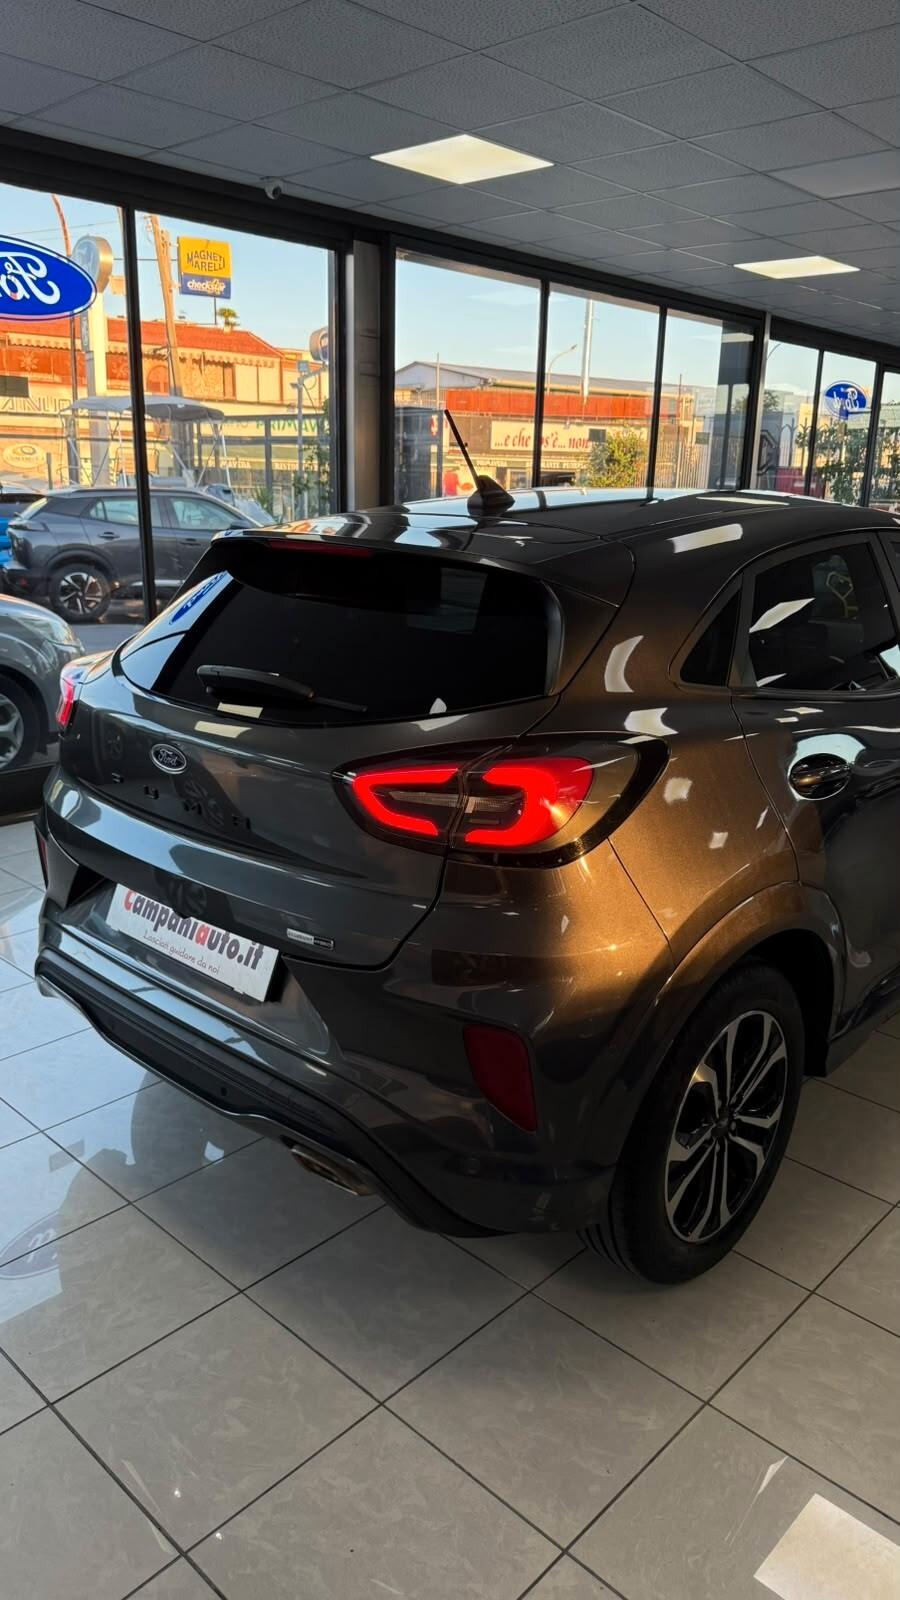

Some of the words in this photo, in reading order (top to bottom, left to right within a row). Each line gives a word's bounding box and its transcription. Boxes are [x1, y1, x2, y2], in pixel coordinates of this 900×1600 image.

[187, 249, 225, 264] MAGNETI
[187, 259, 226, 272] MARELLI
[124, 889, 265, 970] Campaniauto.it
[197, 955, 207, 969] da
[208, 964, 220, 975] noi
